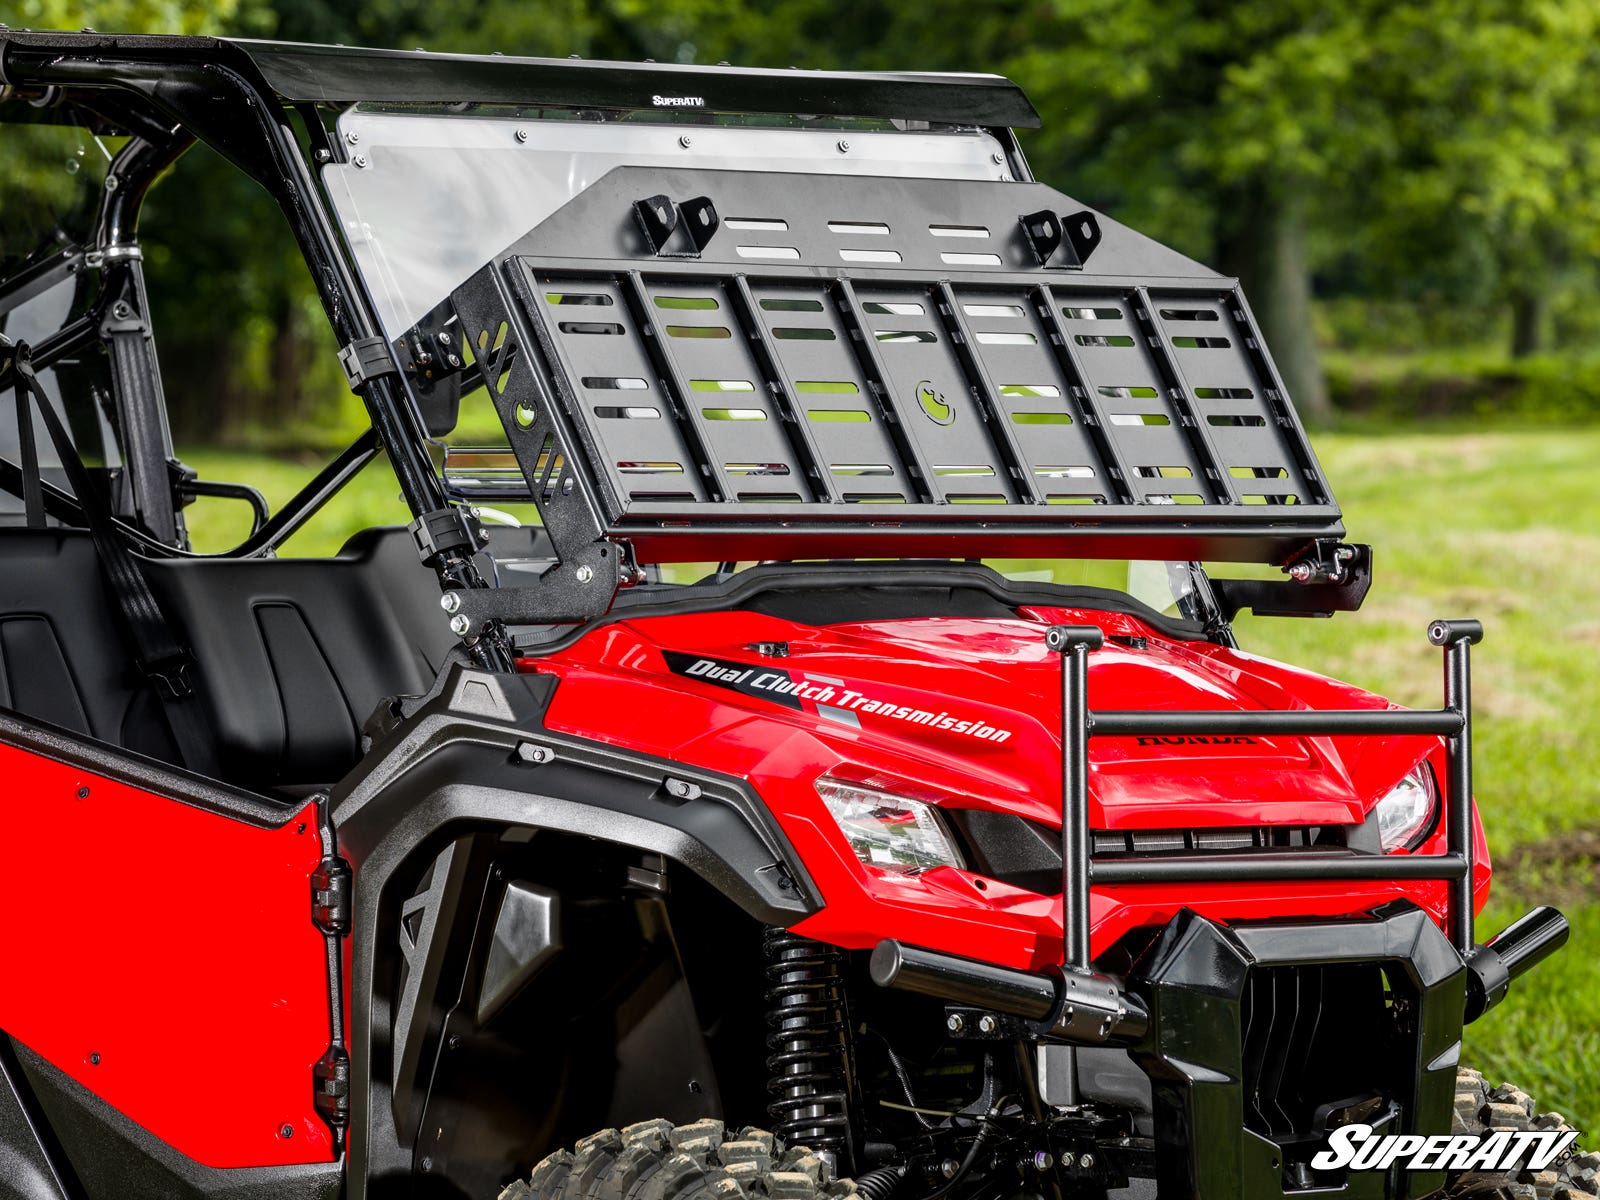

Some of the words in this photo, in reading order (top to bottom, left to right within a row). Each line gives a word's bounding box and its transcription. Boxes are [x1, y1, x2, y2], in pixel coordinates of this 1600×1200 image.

[685, 659, 752, 684] Dual
[750, 672, 836, 702] Clutch
[836, 689, 1012, 743] Transmission
